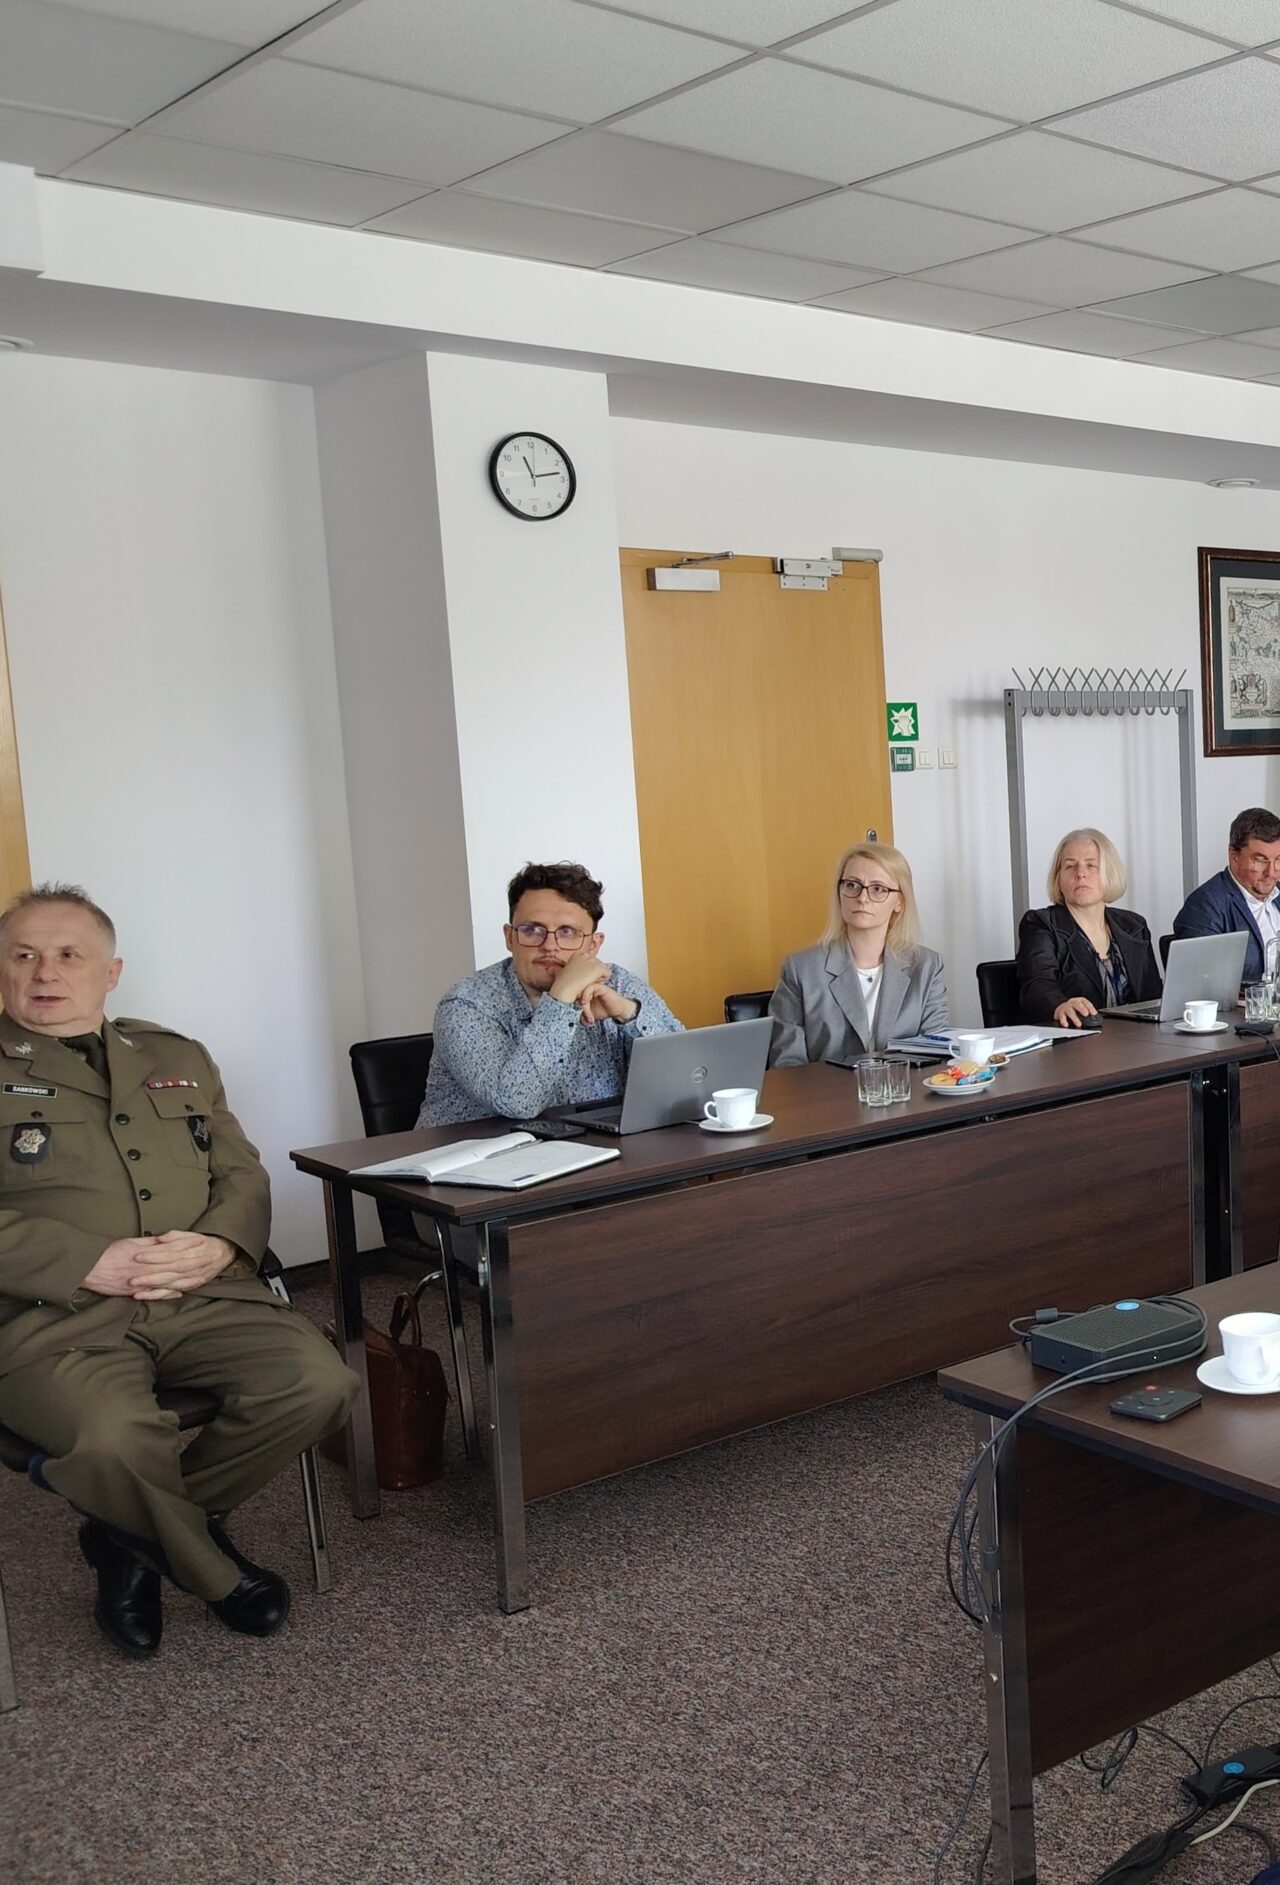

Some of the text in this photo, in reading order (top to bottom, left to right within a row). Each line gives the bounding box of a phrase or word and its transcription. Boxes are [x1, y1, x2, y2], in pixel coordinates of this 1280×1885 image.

[527, 441, 535, 449] 12
[503, 454, 512, 462] 10
[499, 470, 505, 478] 9
[547, 501, 553, 509] 5
